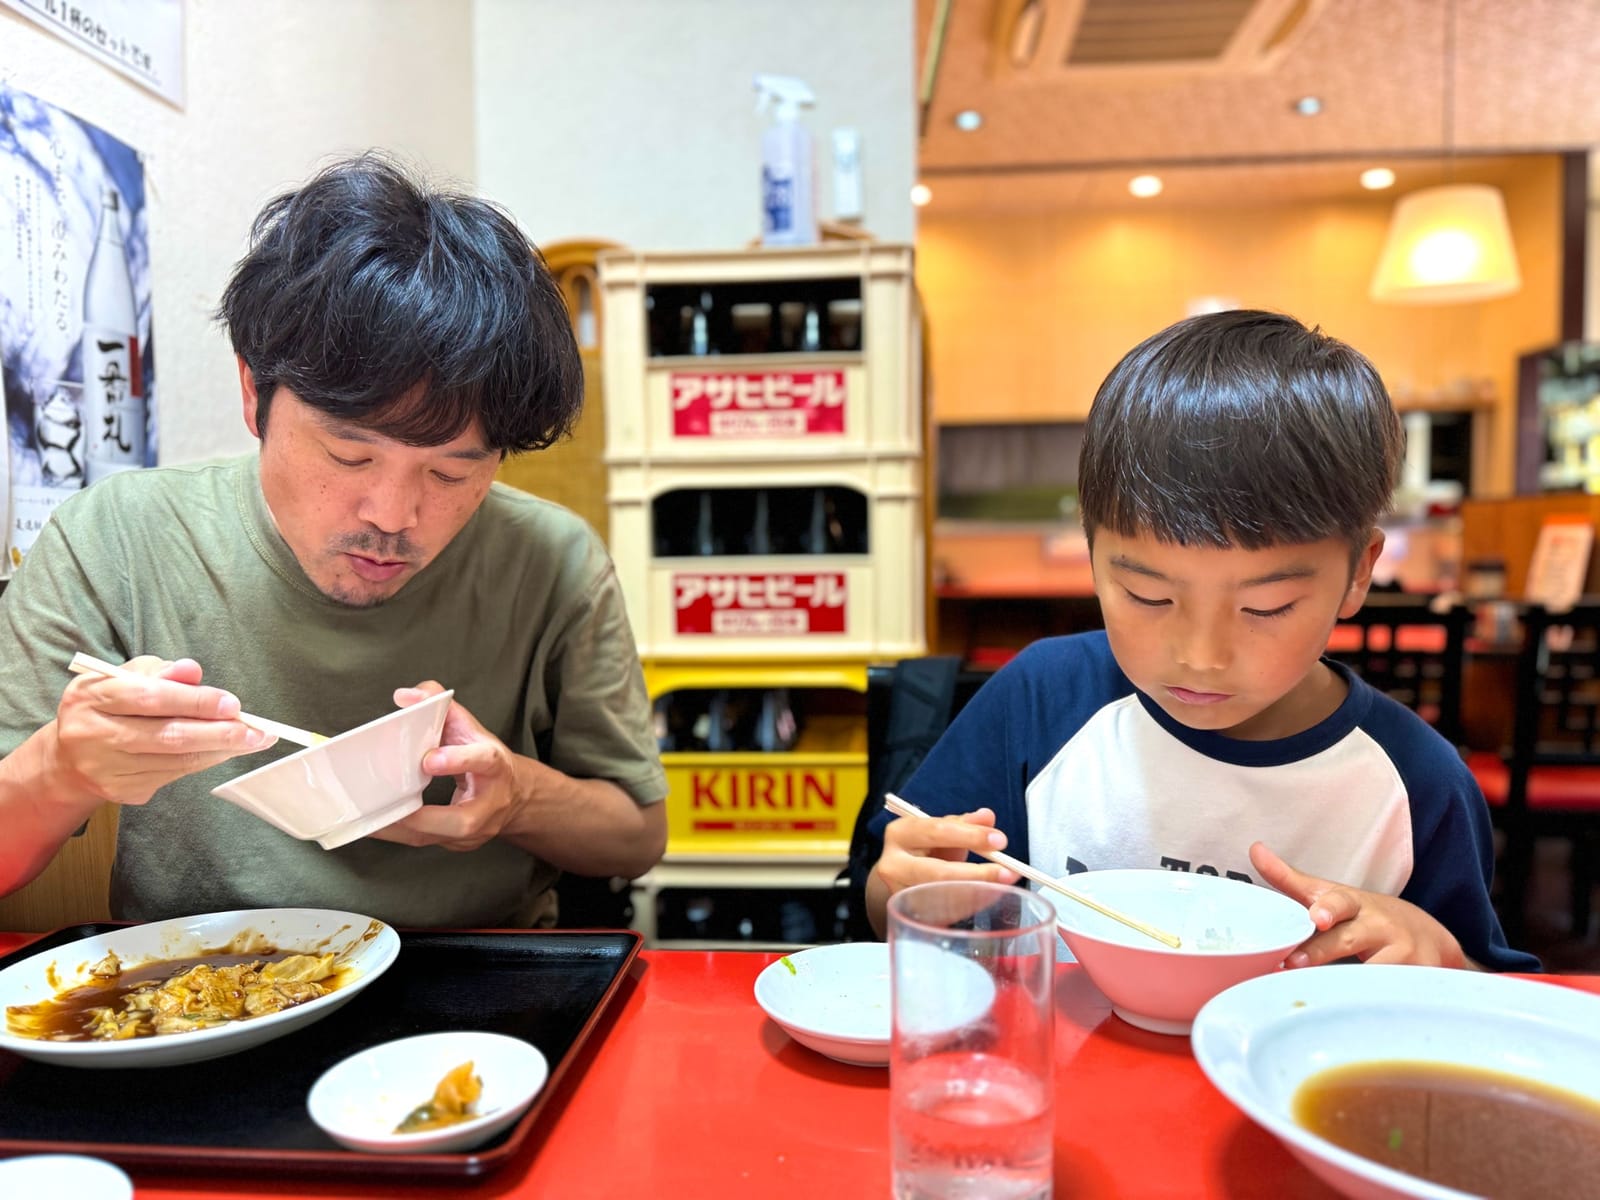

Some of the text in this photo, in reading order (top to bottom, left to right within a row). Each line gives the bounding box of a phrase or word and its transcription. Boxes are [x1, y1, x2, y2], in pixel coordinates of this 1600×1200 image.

[673, 374, 844, 410] アサヒビール
[675, 574, 846, 609] アサヒビール
[692, 771, 836, 808] KIRIN
